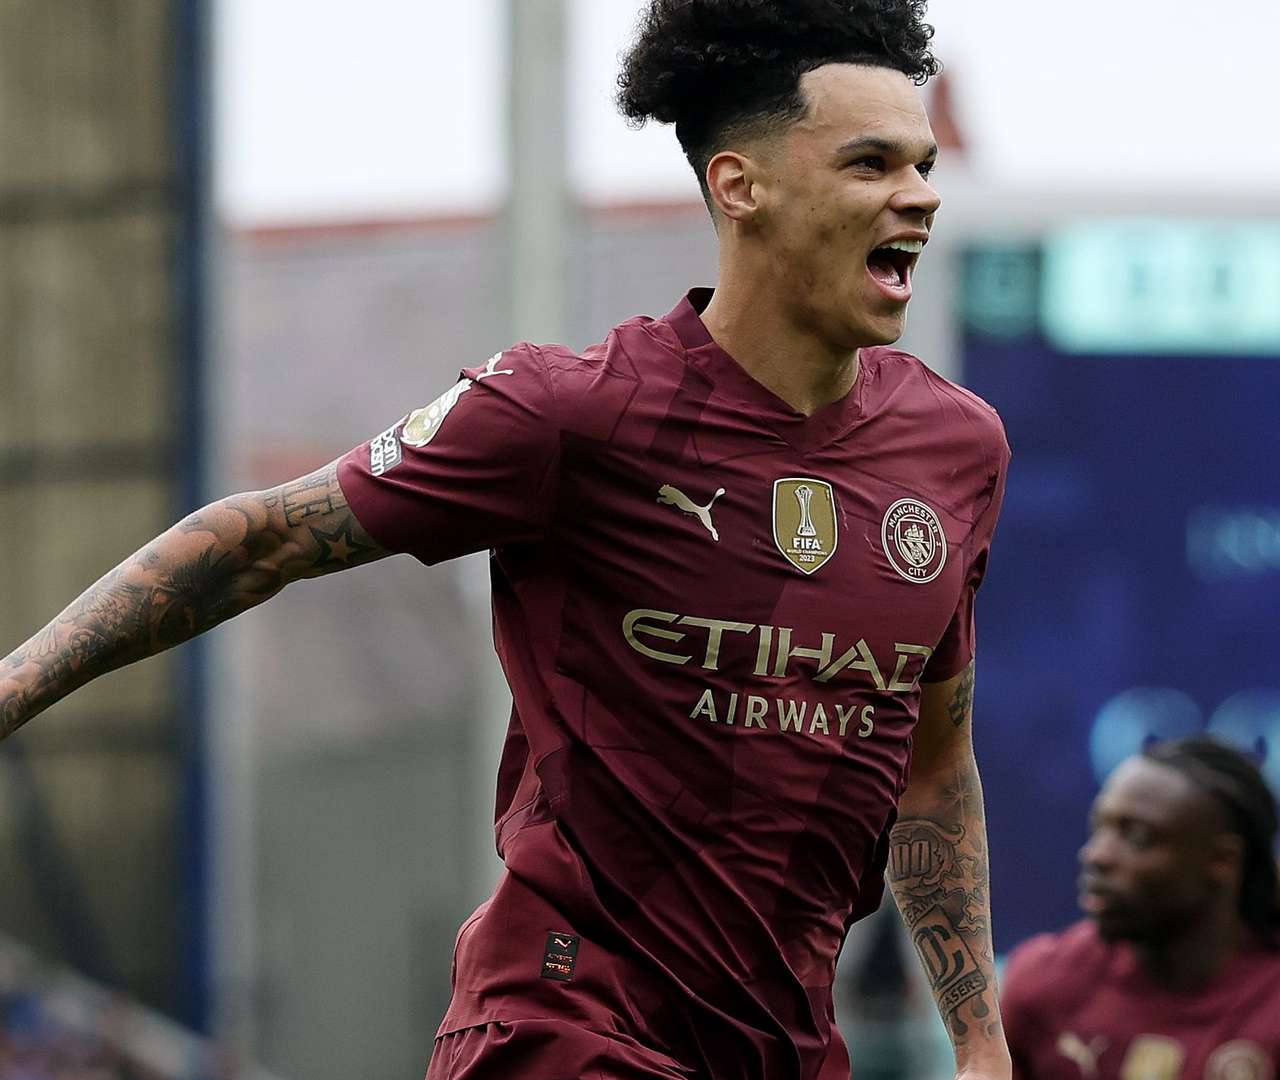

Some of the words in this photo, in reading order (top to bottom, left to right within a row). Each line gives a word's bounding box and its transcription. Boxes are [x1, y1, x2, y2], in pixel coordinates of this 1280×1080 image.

[888, 504, 938, 533] MANCHESTER
[793, 537, 821, 550] FIFA
[908, 567, 927, 577] CITY
[622, 608, 935, 692] ETIHAD
[690, 689, 875, 737] AIRWAYS
